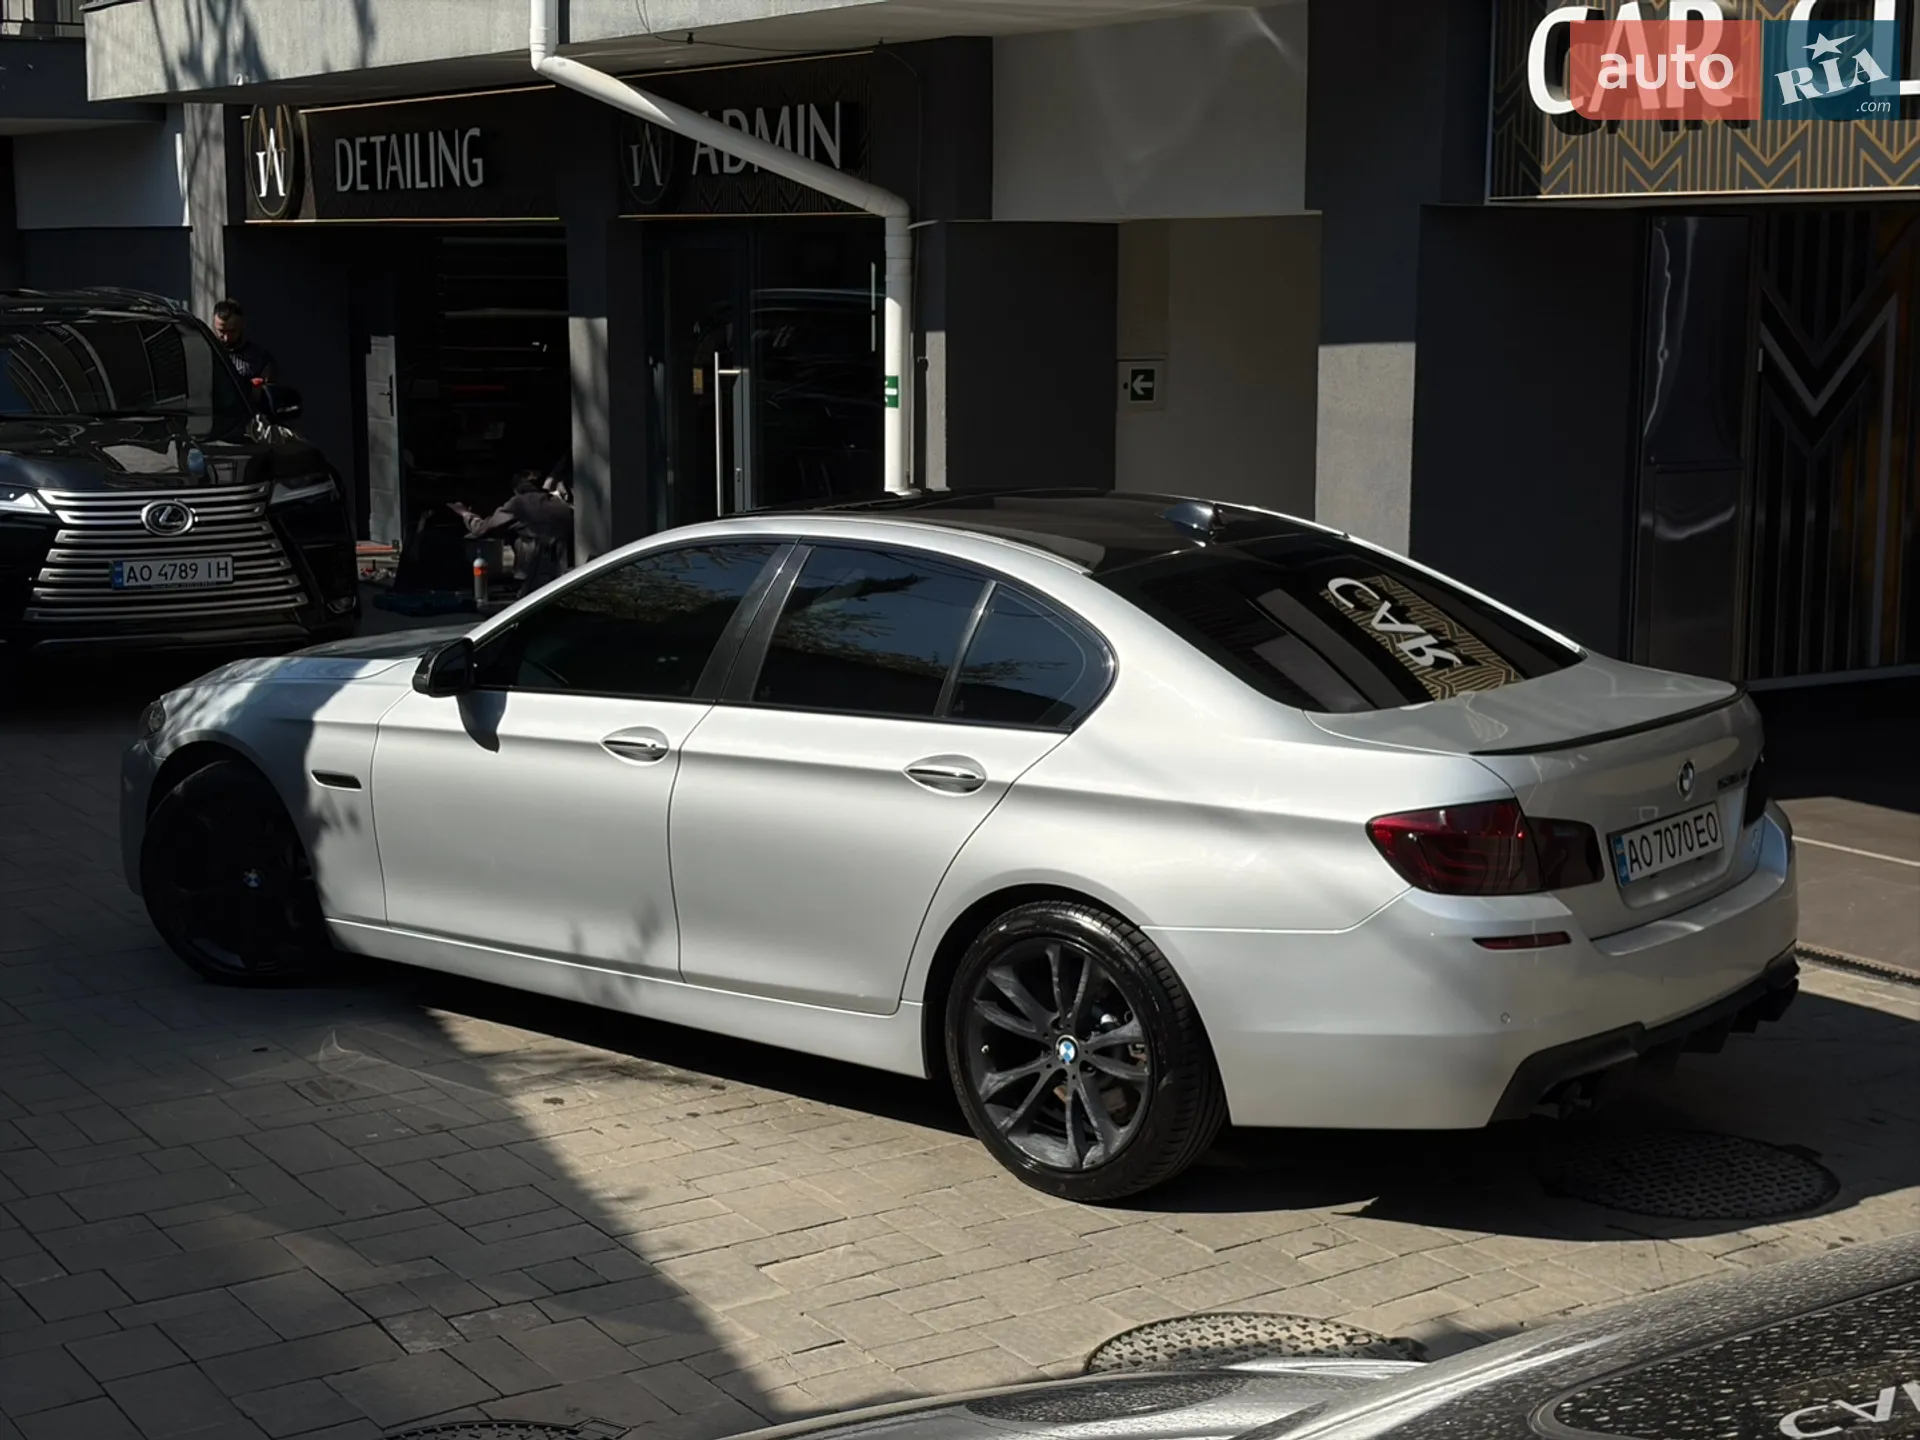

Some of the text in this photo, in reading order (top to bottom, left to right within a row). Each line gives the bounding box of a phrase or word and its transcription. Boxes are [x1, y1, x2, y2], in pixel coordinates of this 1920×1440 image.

[1527, 0, 1733, 114] CAR
[335, 127, 484, 193] DETAILING
[691, 101, 841, 177] ADMIN
[126, 565, 152, 583] AO
[158, 562, 199, 581] 4789
[207, 560, 229, 579] IH
